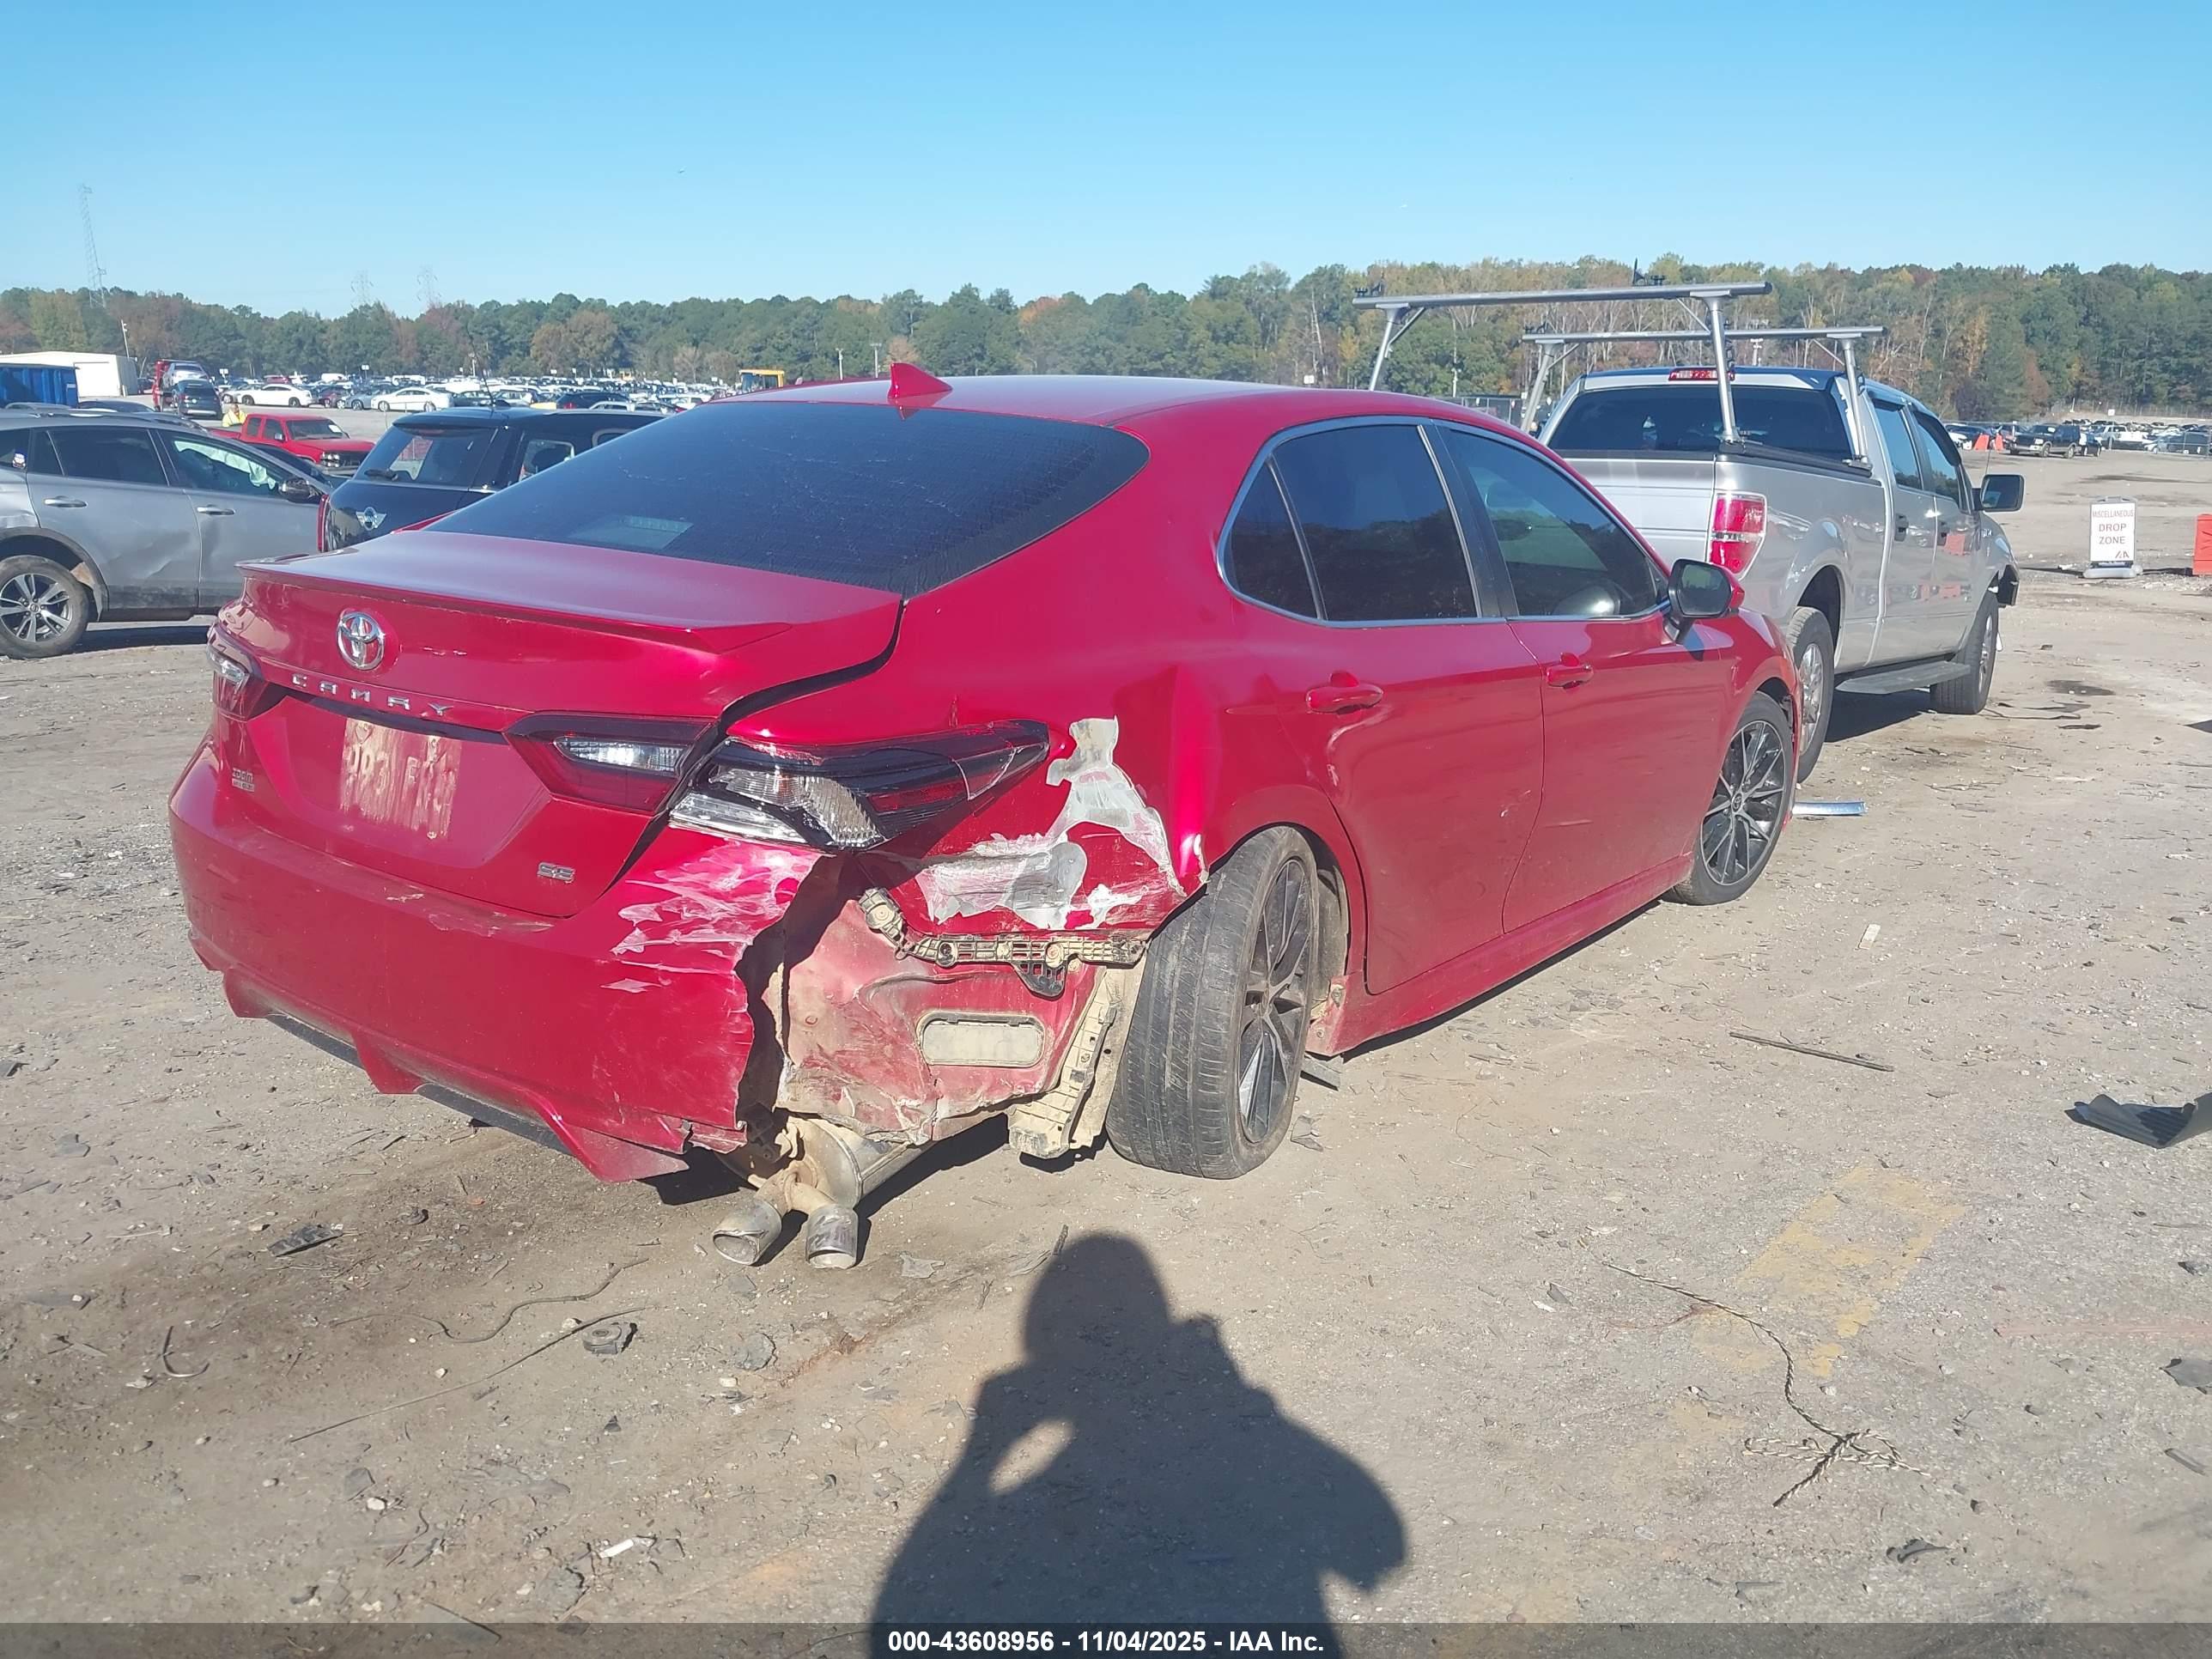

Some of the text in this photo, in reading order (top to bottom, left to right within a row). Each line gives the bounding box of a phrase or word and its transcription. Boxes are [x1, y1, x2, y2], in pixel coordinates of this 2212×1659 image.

[2093, 509, 2134, 518] MISCELLANEOUS
[2099, 523, 2127, 532] DROP
[2099, 536, 2126, 544] ZONE
[292, 672, 454, 716] CAMRY
